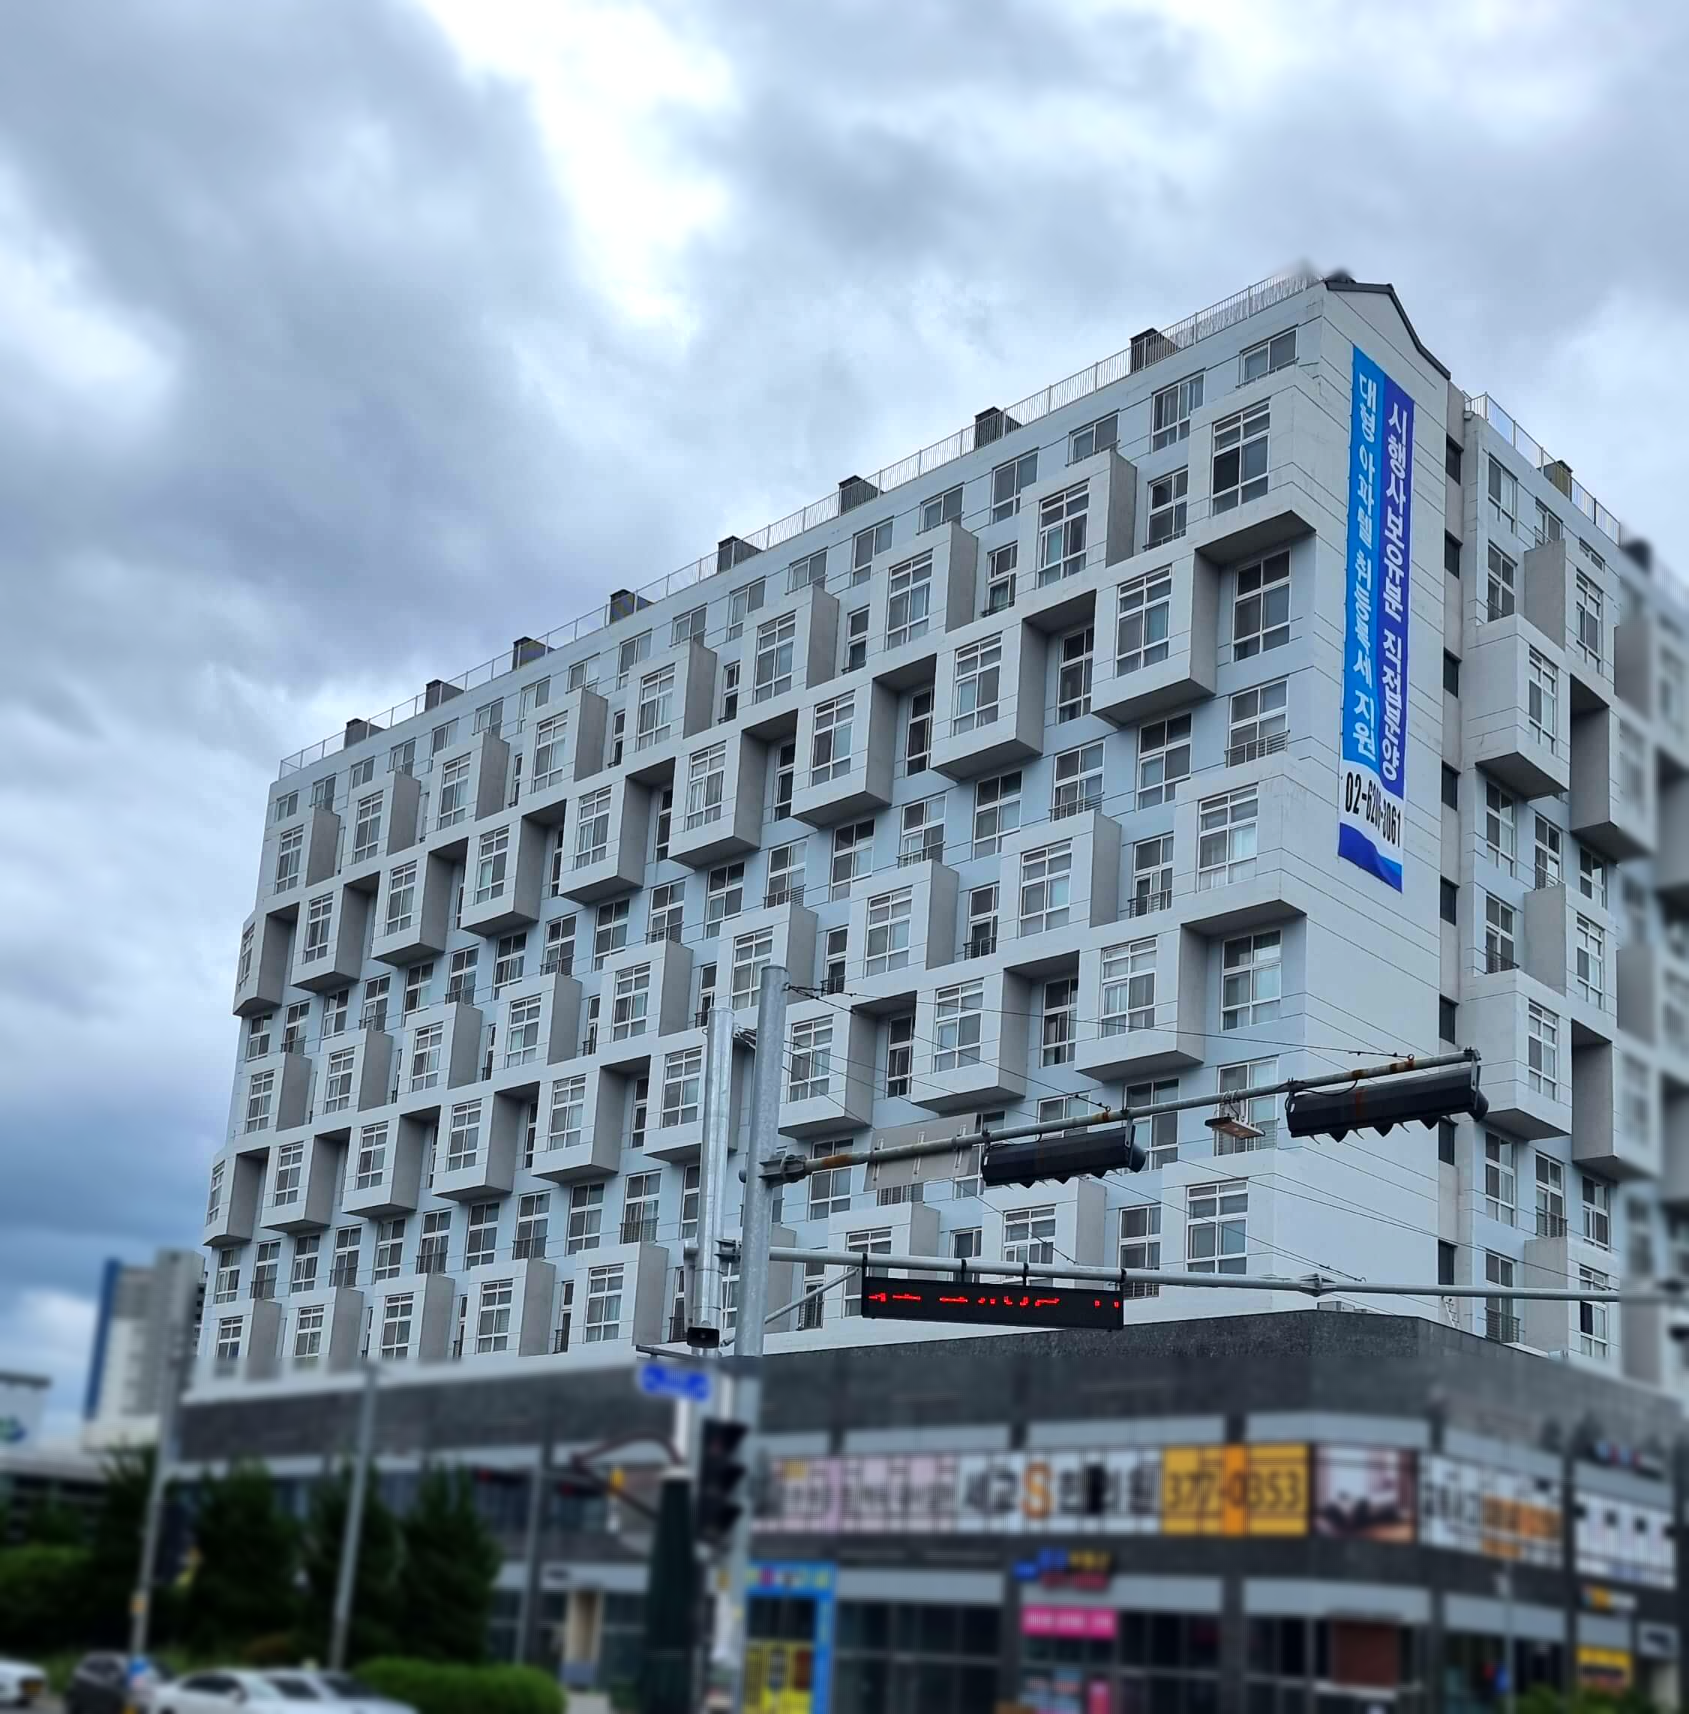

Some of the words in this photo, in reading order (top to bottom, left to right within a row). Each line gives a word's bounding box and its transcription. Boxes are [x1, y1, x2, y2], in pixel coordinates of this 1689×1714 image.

[1359, 372, 1377, 443] 대형
[1357, 444, 1376, 549] 아파텔
[1353, 690, 1376, 762] 지원
[1382, 628, 1402, 781] 직접분양
